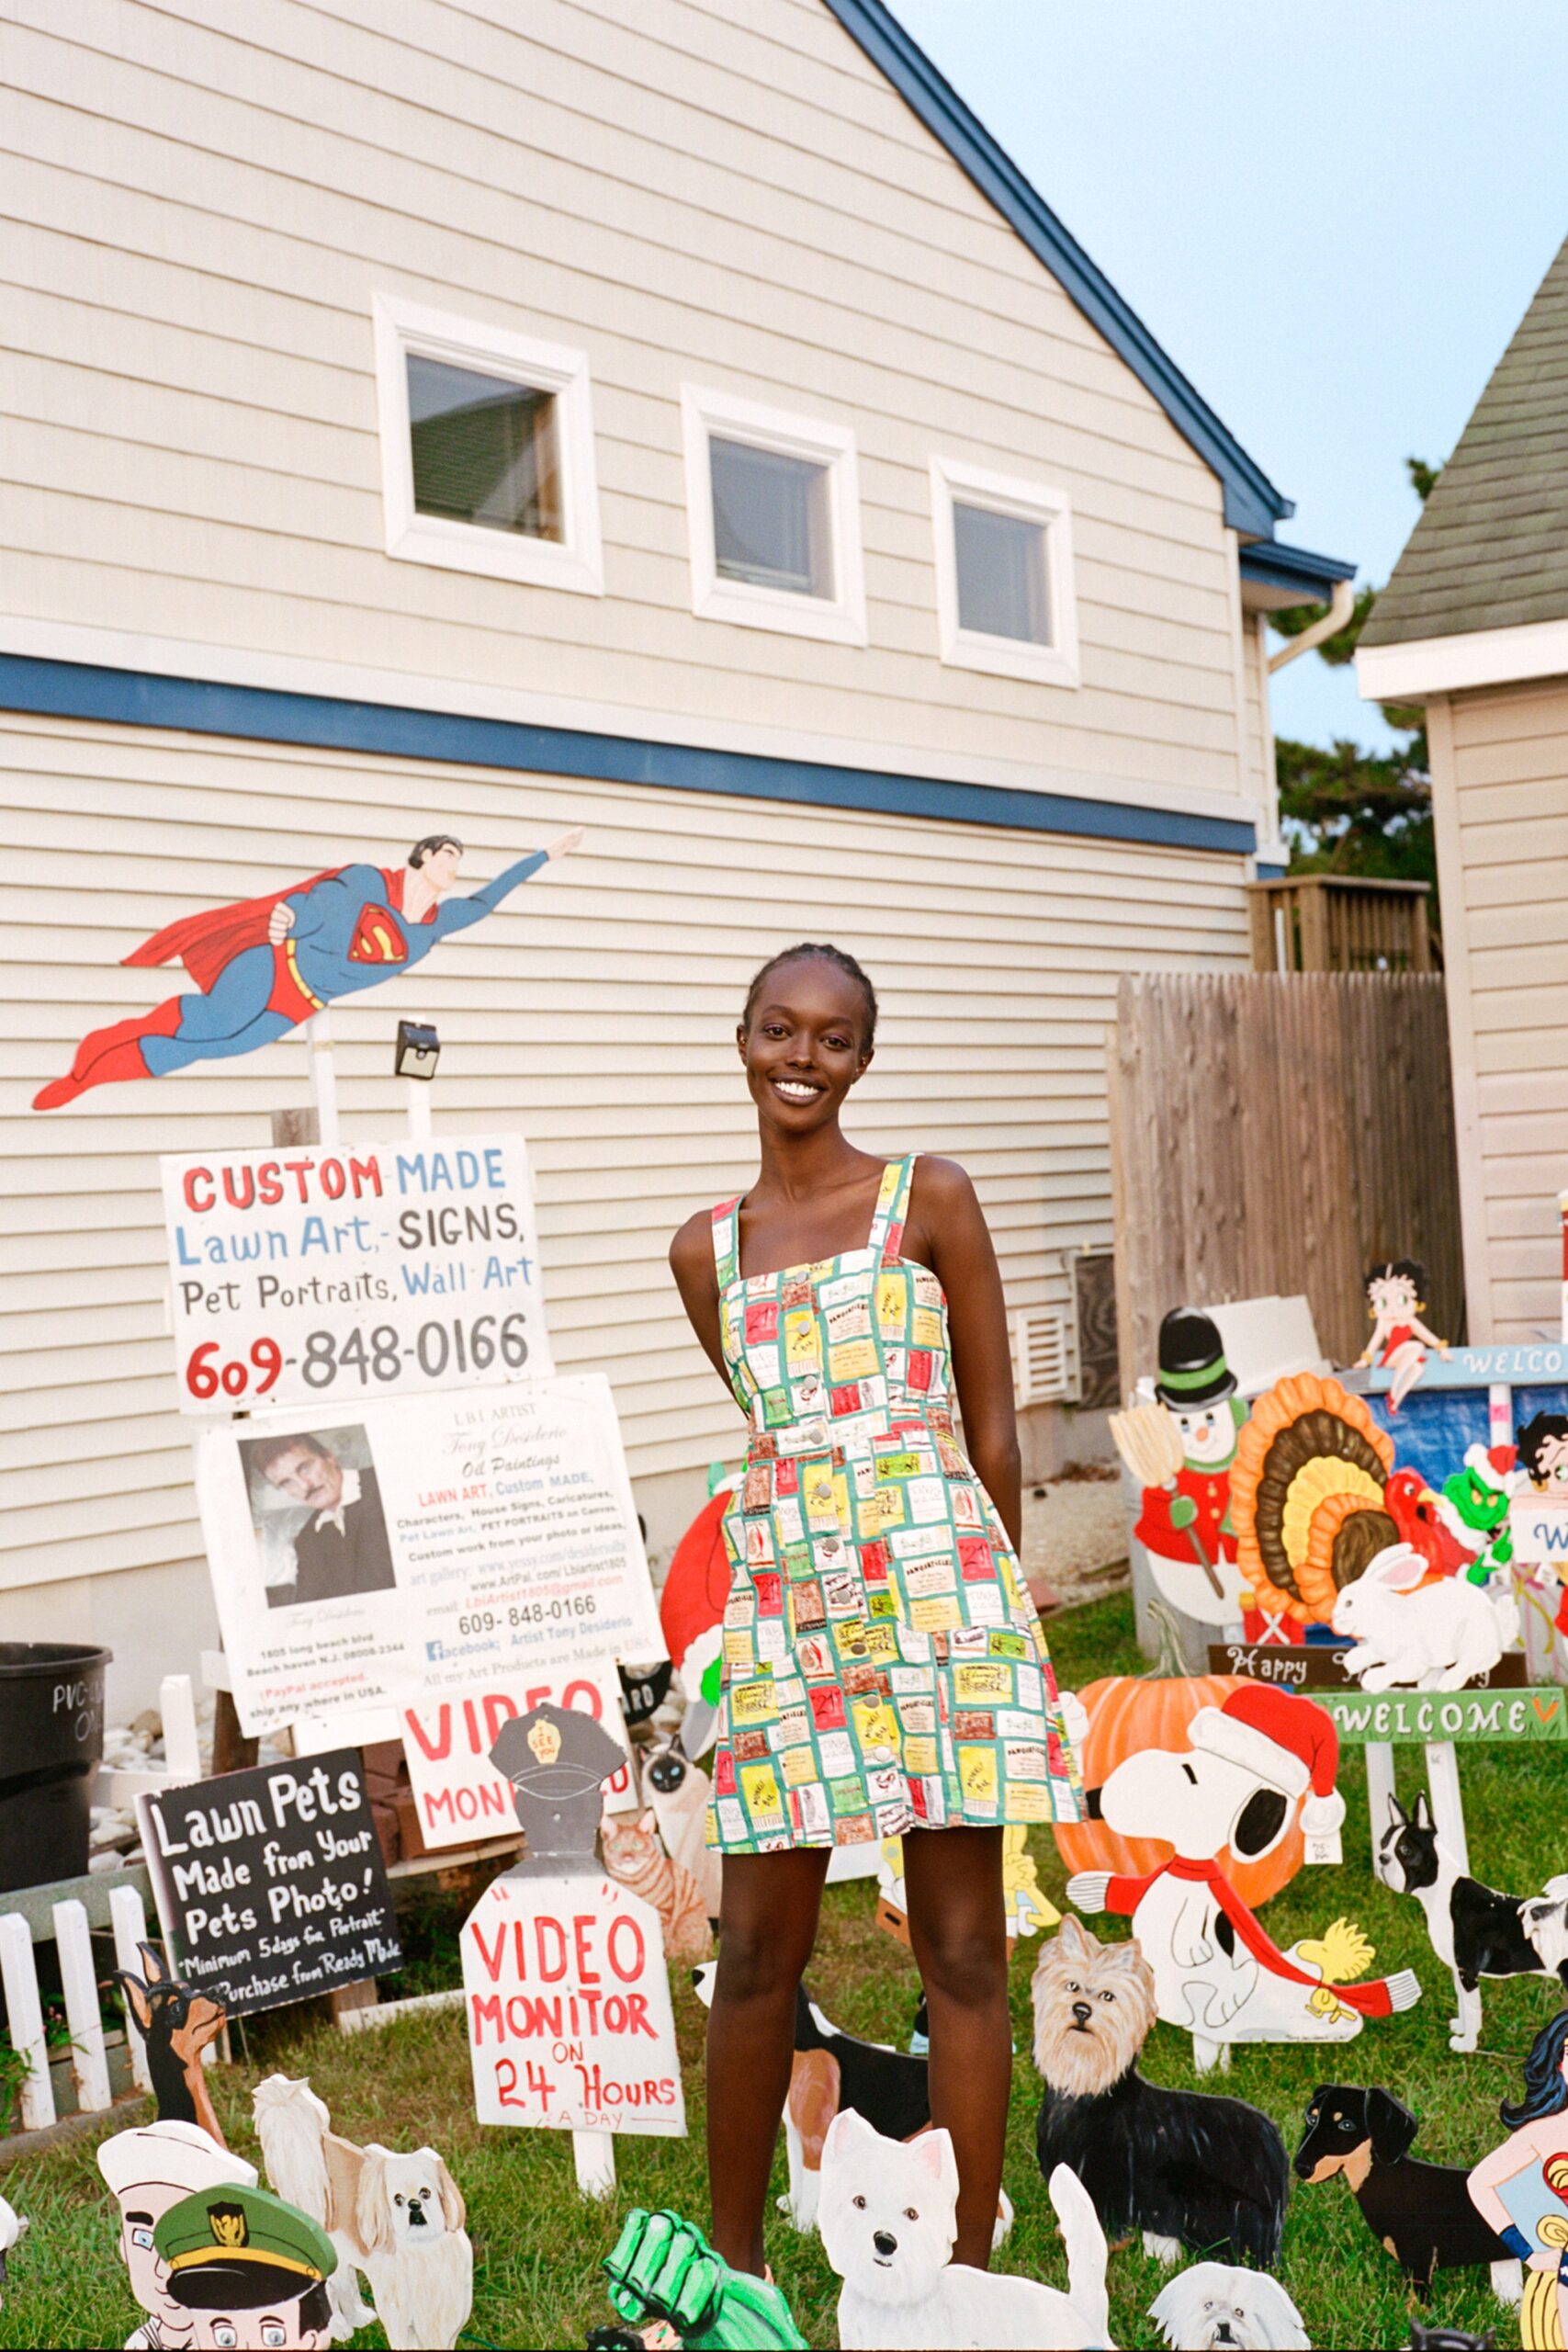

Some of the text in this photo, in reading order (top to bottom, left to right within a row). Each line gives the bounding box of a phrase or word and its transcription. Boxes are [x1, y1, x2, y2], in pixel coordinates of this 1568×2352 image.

[183, 1148, 506, 1213] CUSTOM MADE
[175, 1226, 288, 1266] Lawn
[398, 1203, 525, 1250] SIGNS,
[178, 1256, 534, 1316] Pet Portraits, Wall Art
[186, 1312, 530, 1400] 609-848-0166
[491, 1403, 536, 1420] ARTIST
[462, 1453, 561, 1478] Oil Paintings
[397, 1488, 615, 1529] Characters, House Signs, Caricatures,
[418, 1487, 458, 1508] LAWN
[495, 1478, 544, 1497] Custom
[549, 1471, 594, 1487] MADE,
[399, 1530, 420, 1543] Pet
[423, 1526, 455, 1540] Lawn
[480, 1519, 501, 1532] PET
[504, 1511, 564, 1527] PORTRAITS
[567, 1509, 579, 1519] on
[408, 1520, 626, 1563] Custom work from your photo or ideas,
[289, 1644, 313, 1655] long
[316, 1638, 348, 1650] beach
[351, 1634, 374, 1645] blvd
[511, 1631, 545, 1647] Artist
[547, 1625, 576, 1642] Tony
[580, 1617, 633, 1635] Desiderio
[247, 1665, 280, 1678] Beach
[283, 1659, 317, 1671] haven
[423, 1669, 441, 1688] All
[445, 1669, 464, 1686] my
[467, 1664, 488, 1680] Art
[492, 1656, 547, 1676] Products
[550, 1653, 570, 1664] are
[573, 1645, 606, 1663] Made
[608, 1645, 621, 1656] in
[1226, 1646, 1307, 1684] Happy
[250, 1707, 275, 1720] ship
[278, 1702, 300, 1713] any
[304, 1693, 340, 1709] where
[344, 1690, 355, 1701] in
[1334, 1700, 1528, 1735] WELCOME
[151, 1767, 361, 1857] Lawn Pets
[172, 1828, 372, 1902] Made from Your
[185, 1902, 258, 1946] Pets
[291, 1960, 323, 1985] from
[319, 1948, 366, 1974] Ready
[470, 1915, 645, 1984] VIDEO
[471, 1989, 660, 2046] MONITOR
[552, 2041, 584, 2064] ON
[495, 2058, 556, 2112] 24
[584, 2111, 624, 2131] DAY
